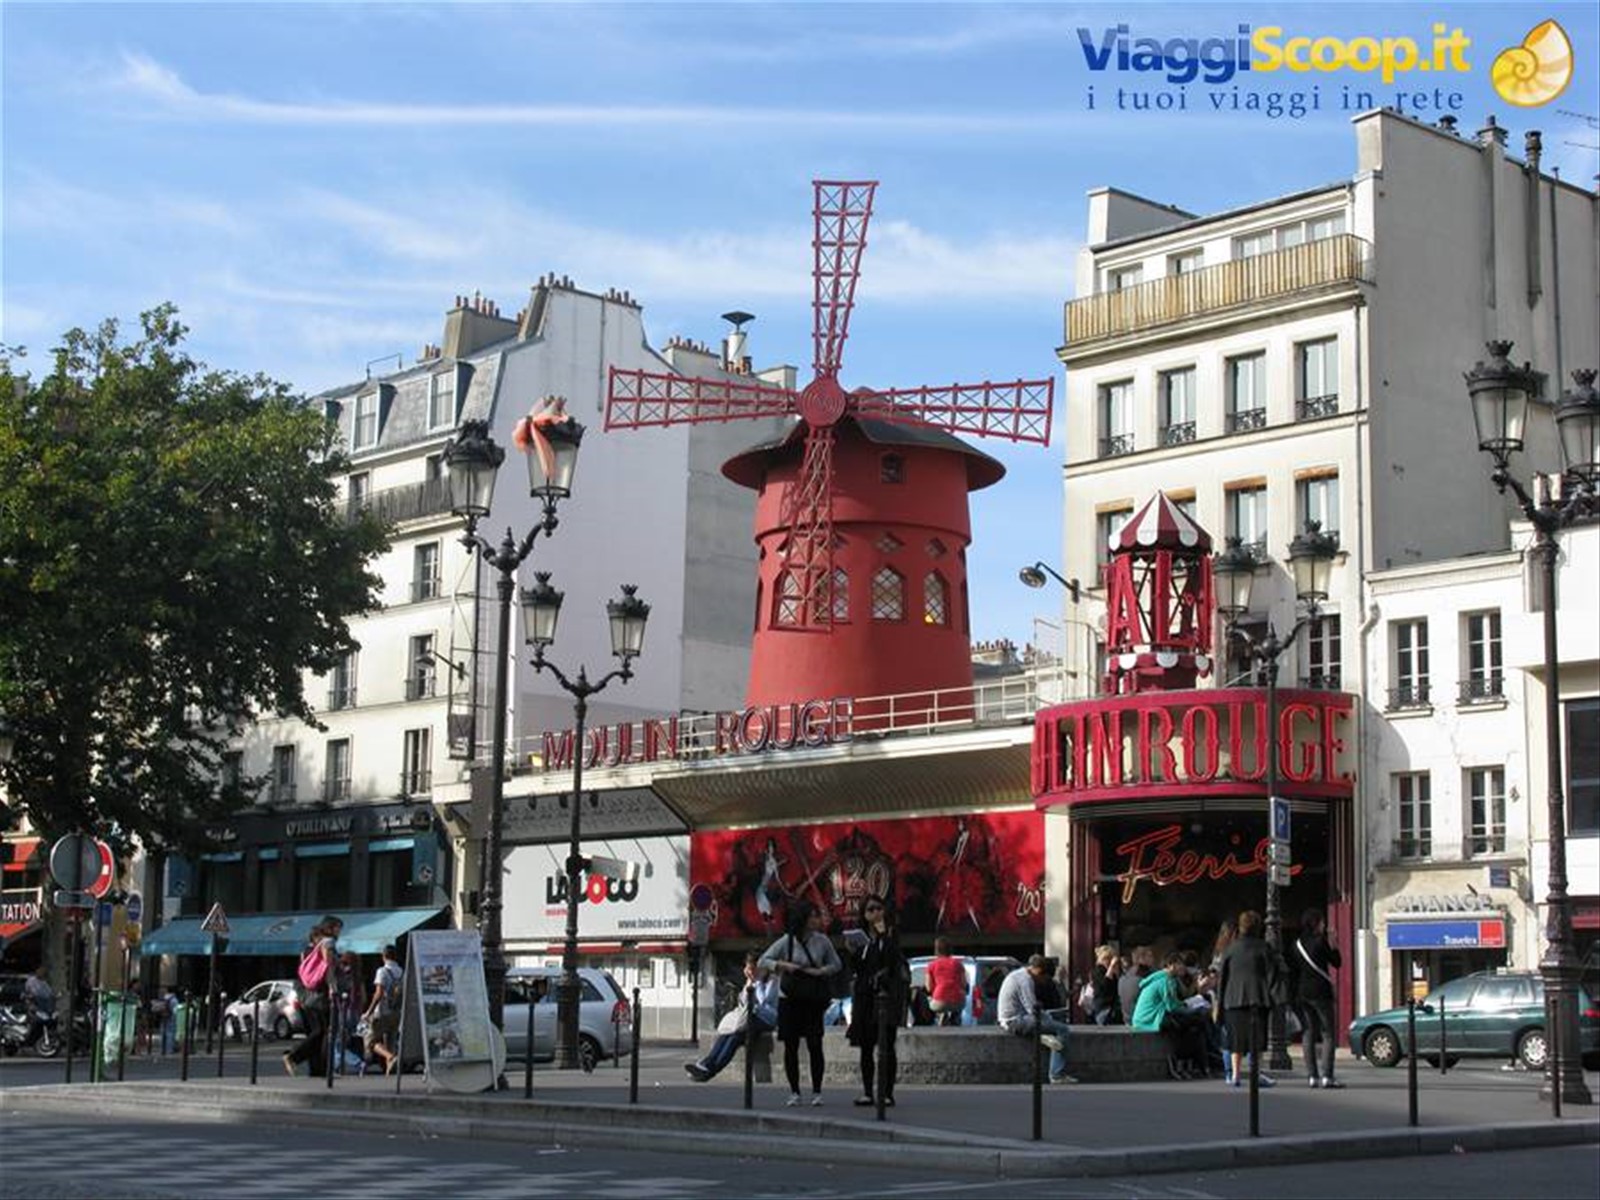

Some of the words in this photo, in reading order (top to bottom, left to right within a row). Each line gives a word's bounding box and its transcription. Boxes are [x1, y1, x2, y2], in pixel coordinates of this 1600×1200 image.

[541, 711, 678, 771] MOULIN
[715, 697, 854, 756] ROUGE
[1137, 699, 1355, 785] ROUGE
[831, 858, 890, 905] 120
[1394, 893, 1493, 912] CHANGE
